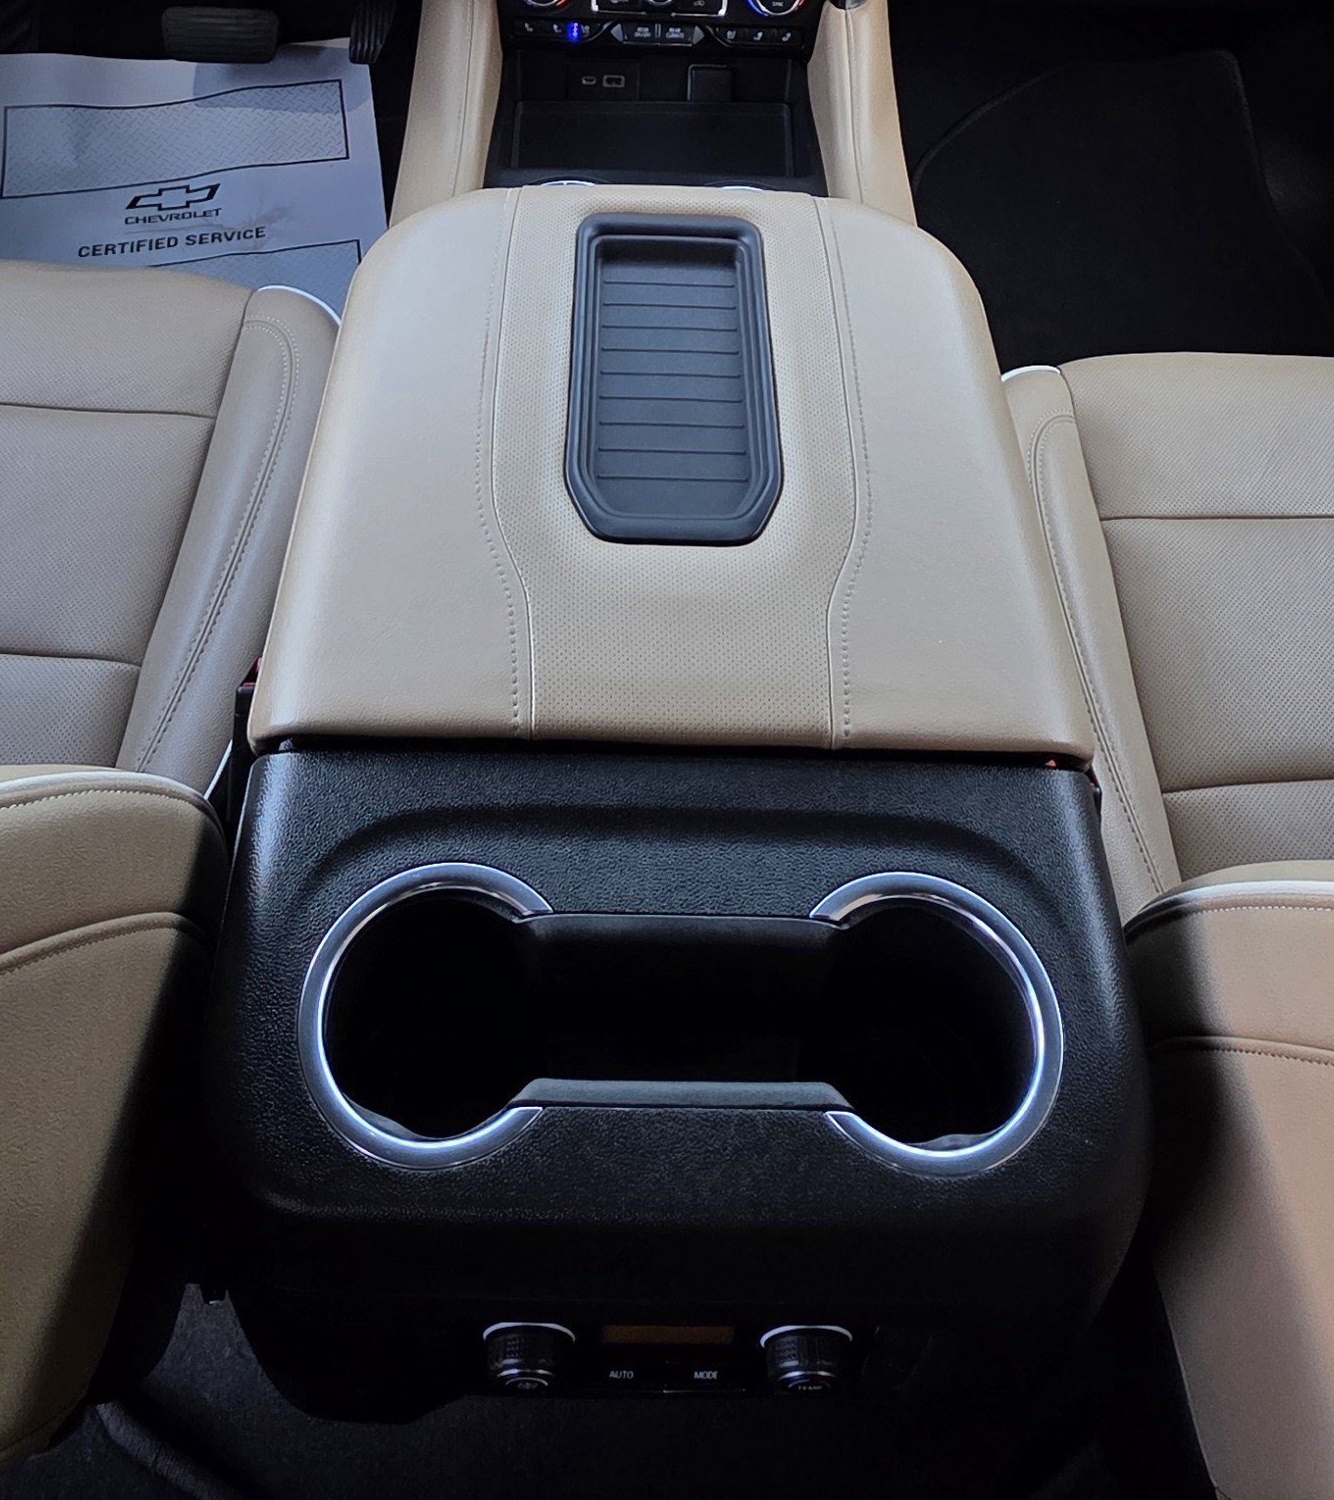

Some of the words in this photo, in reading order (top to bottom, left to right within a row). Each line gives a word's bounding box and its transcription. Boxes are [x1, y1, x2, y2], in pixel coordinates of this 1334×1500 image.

[124, 207, 223, 226] CHEVROLET
[77, 236, 179, 258] CERTIFIED
[184, 225, 266, 246] SERVICE
[608, 1370, 634, 1380] AUTO
[693, 1370, 718, 1380] MODE
